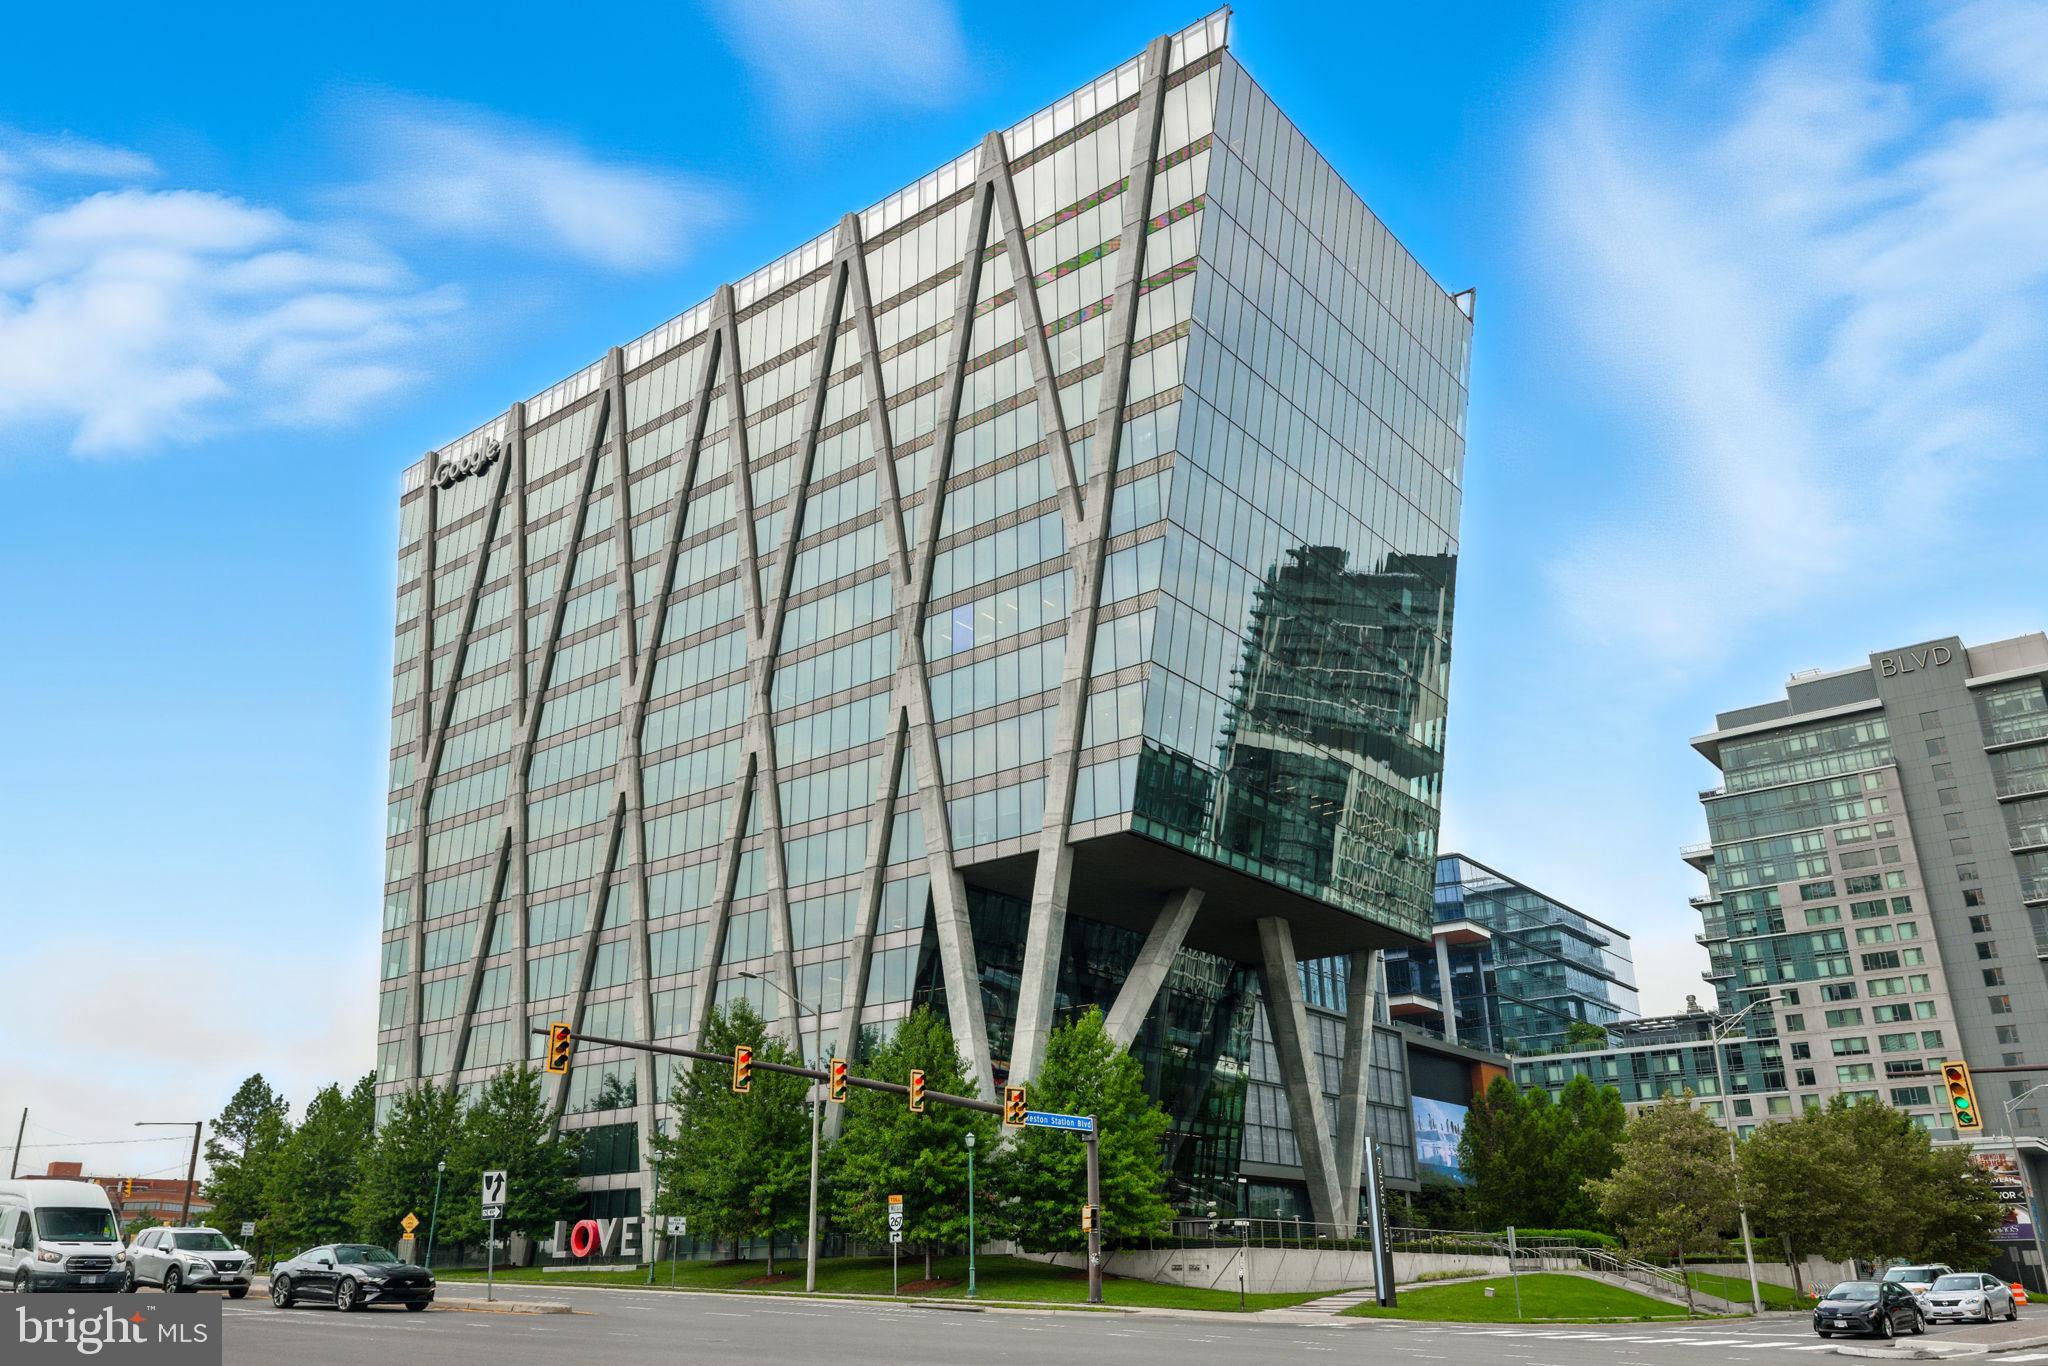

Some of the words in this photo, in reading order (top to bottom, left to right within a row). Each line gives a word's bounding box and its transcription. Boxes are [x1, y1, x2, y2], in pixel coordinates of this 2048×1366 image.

[434, 438, 500, 488] Google
[1880, 646, 1951, 677] BLVD
[1051, 1117, 1075, 1126] Station
[1077, 1121, 1092, 1129] Blvd
[1376, 1157, 1386, 1205] STATION
[552, 1217, 642, 1259] LOVE
[890, 1216, 903, 1227] 267
[1381, 1207, 1390, 1253] RESTON
